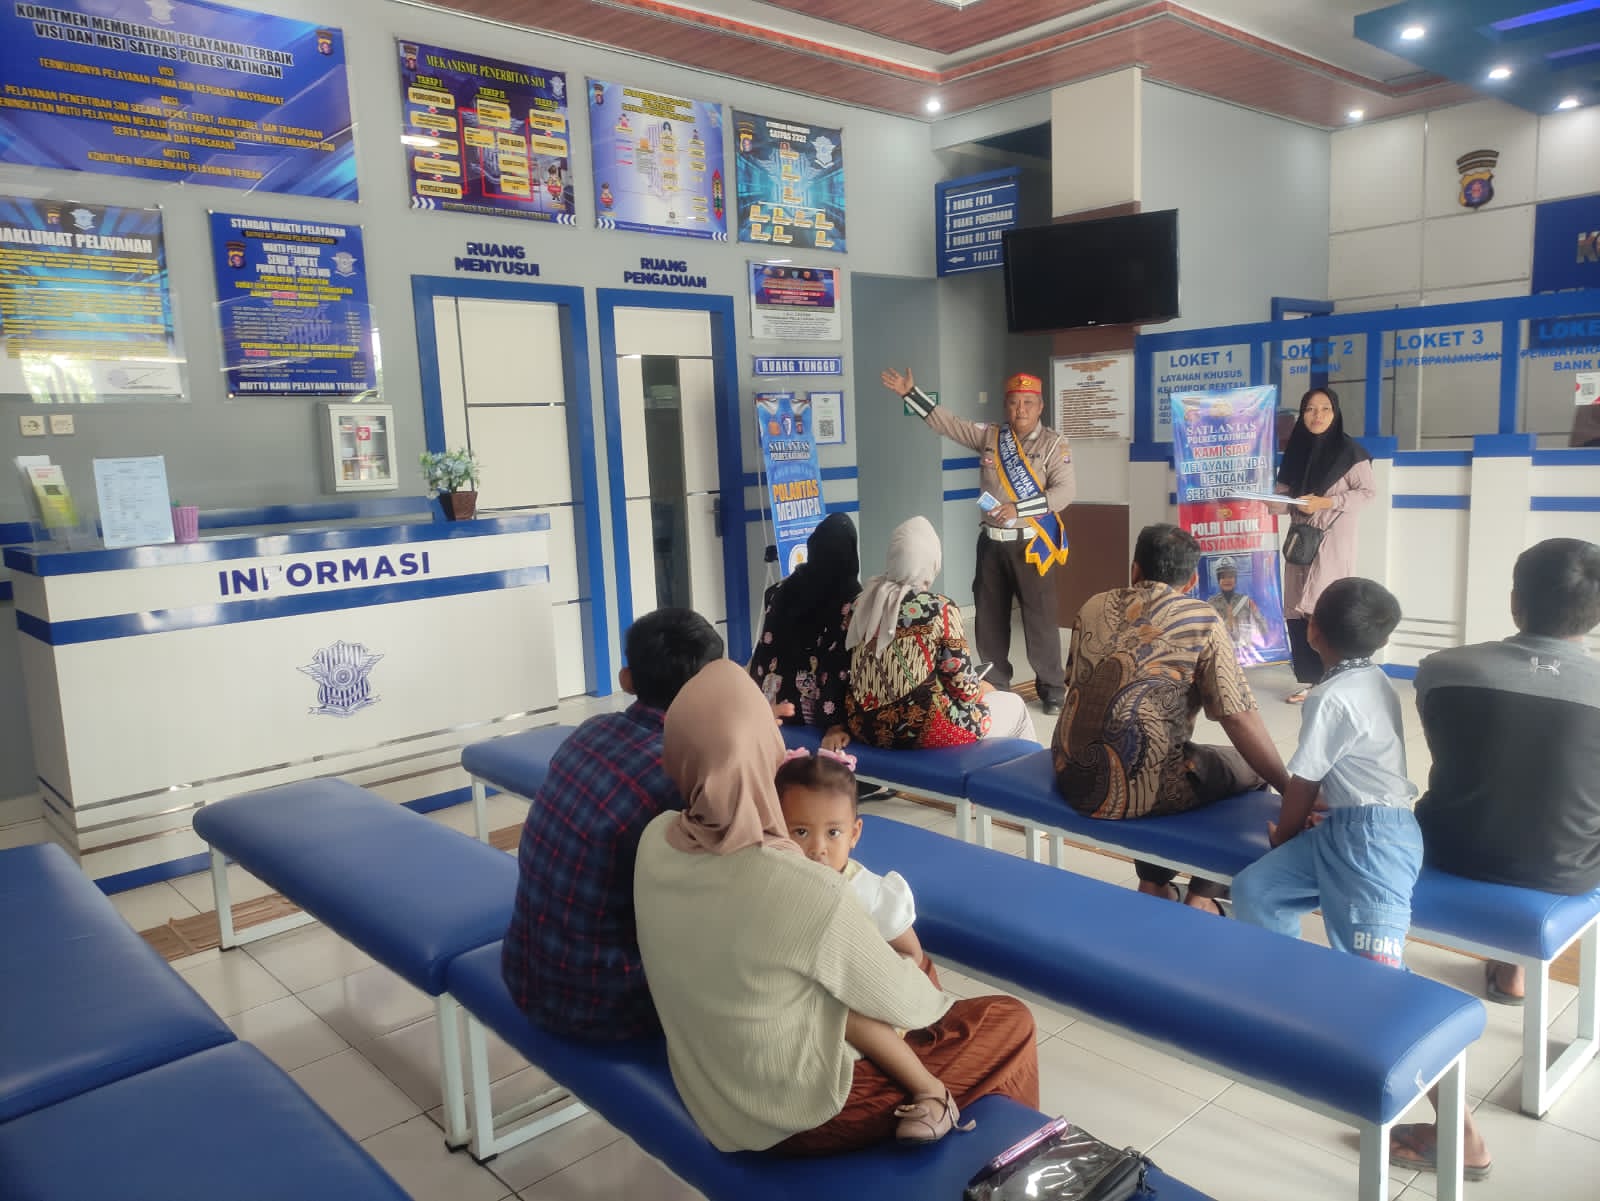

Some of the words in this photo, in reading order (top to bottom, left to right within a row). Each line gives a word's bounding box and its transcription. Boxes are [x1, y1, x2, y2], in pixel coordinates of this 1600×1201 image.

[16, 4, 88, 29] KOMITMEN
[91, 16, 176, 44] MEMBERIKAN
[179, 32, 244, 57] PELAYANAN
[248, 45, 294, 66] TERBAIK
[34, 22, 64, 41] VISI
[66, 28, 93, 46] DAN
[96, 33, 127, 51] MISI
[128, 38, 178, 61] SATPAS
[180, 46, 223, 68] POLRES
[226, 55, 283, 79] KATINGAN
[425, 54, 478, 75] MEKANISME
[479, 64, 530, 85] PENERBITAN
[530, 76, 546, 89] SIM
[5, 84, 58, 101] PELAYANAN
[230, 218, 270, 231] STANDAR
[302, 224, 346, 238] PELAYANAN
[75, 234, 153, 254] PELAYANAN
[466, 241, 526, 260] RUANG
[1576, 231, 1600, 264] K
[454, 257, 541, 277] MENYUSUI
[640, 257, 687, 273] RUANG
[623, 271, 707, 288] PENGADUAN
[1343, 340, 1353, 354] 2
[1397, 330, 1465, 350] LOKET
[1471, 328, 1485, 345] 3
[762, 360, 795, 373] RUANG
[798, 360, 836, 373] TUNGGU
[1170, 351, 1220, 368] LOKET
[1225, 350, 1233, 364] 1
[1406, 352, 1499, 367] PERPANJANGAN
[1552, 360, 1593, 371] BANK
[1160, 371, 1201, 383] LAYANAN
[1203, 369, 1243, 380] KHUSUS
[1157, 384, 1206, 394] KELOMPOK
[1186, 422, 1257, 436] SATLANTAS
[1194, 446, 1223, 459] KAMI
[1182, 459, 1233, 474] MELAYANI
[1200, 471, 1247, 487] DENGAN
[772, 479, 820, 504] POLANTAS
[776, 497, 821, 521] MENYAPA
[1190, 521, 1221, 537] POLRI
[1223, 519, 1260, 534] UNTUK
[1198, 534, 1263, 553] ASYARAKAT
